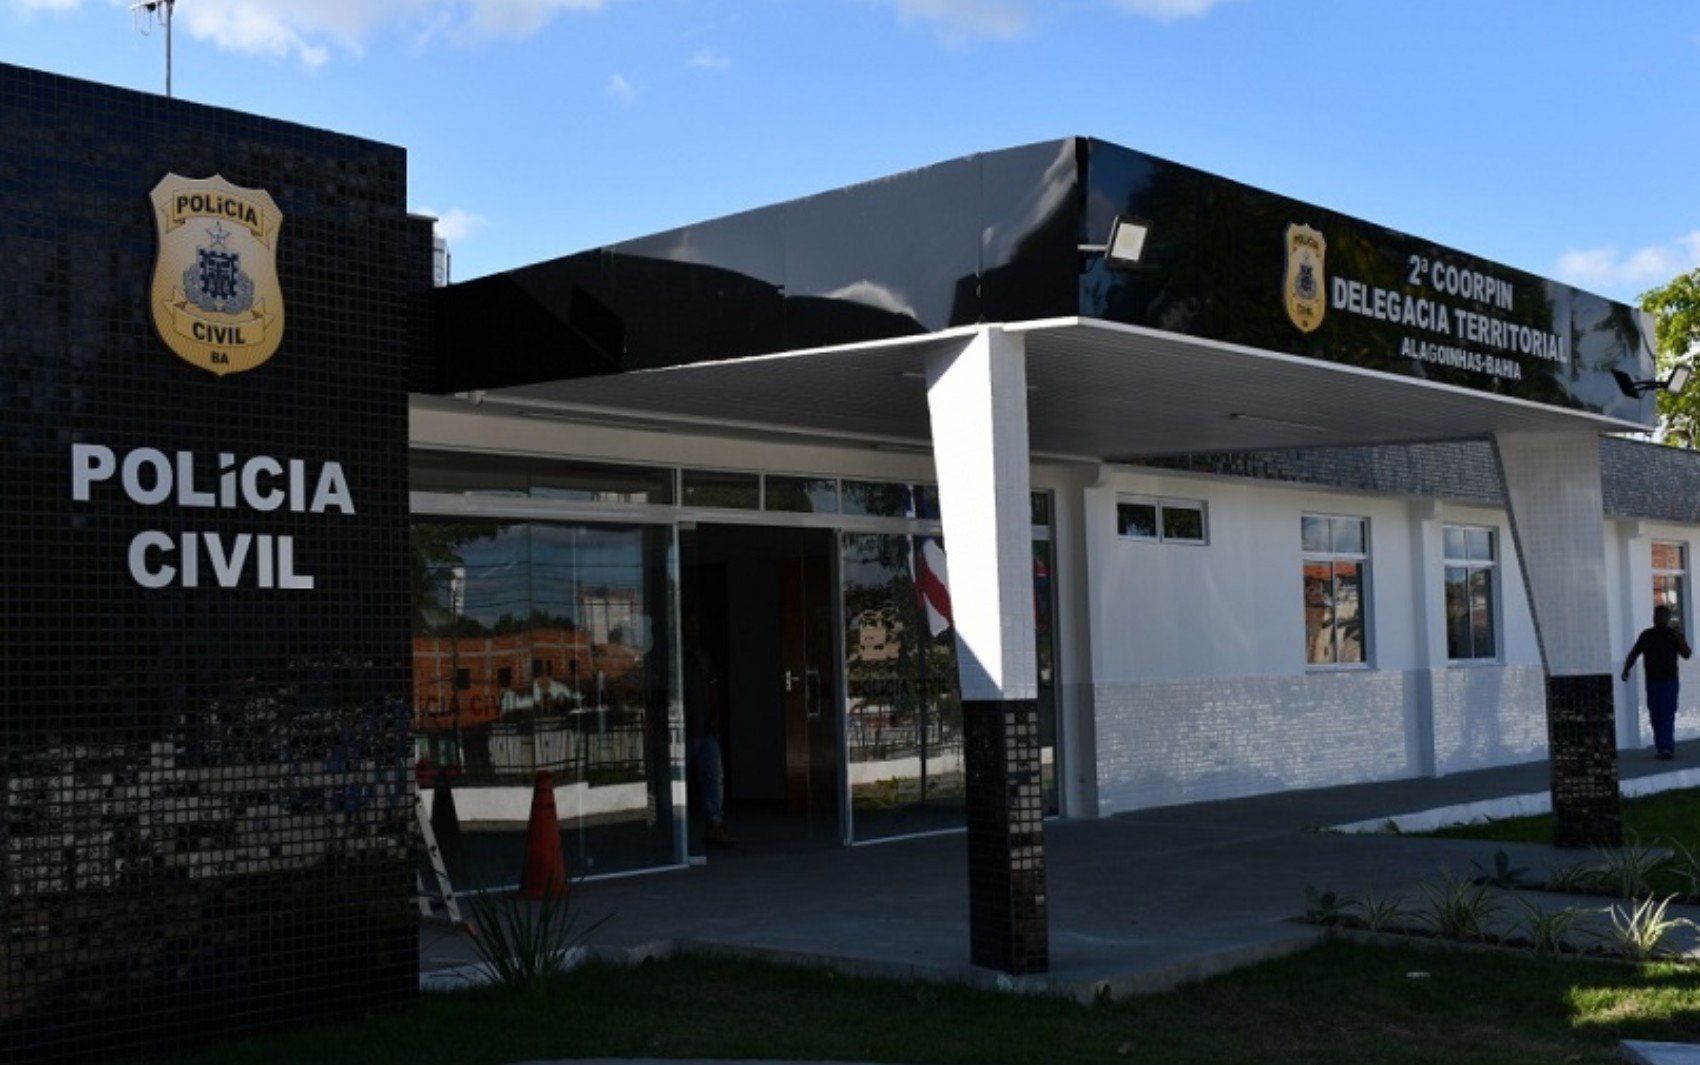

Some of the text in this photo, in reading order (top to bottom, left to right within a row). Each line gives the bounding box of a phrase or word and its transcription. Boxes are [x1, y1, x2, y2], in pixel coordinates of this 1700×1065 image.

[1431, 261, 1514, 311] COORPIN
[193, 321, 246, 345] CIVIL
[1332, 277, 1568, 364] DELEGACIA TERRITORIAL
[211, 351, 229, 365] BA
[128, 530, 315, 589] CIVIL
